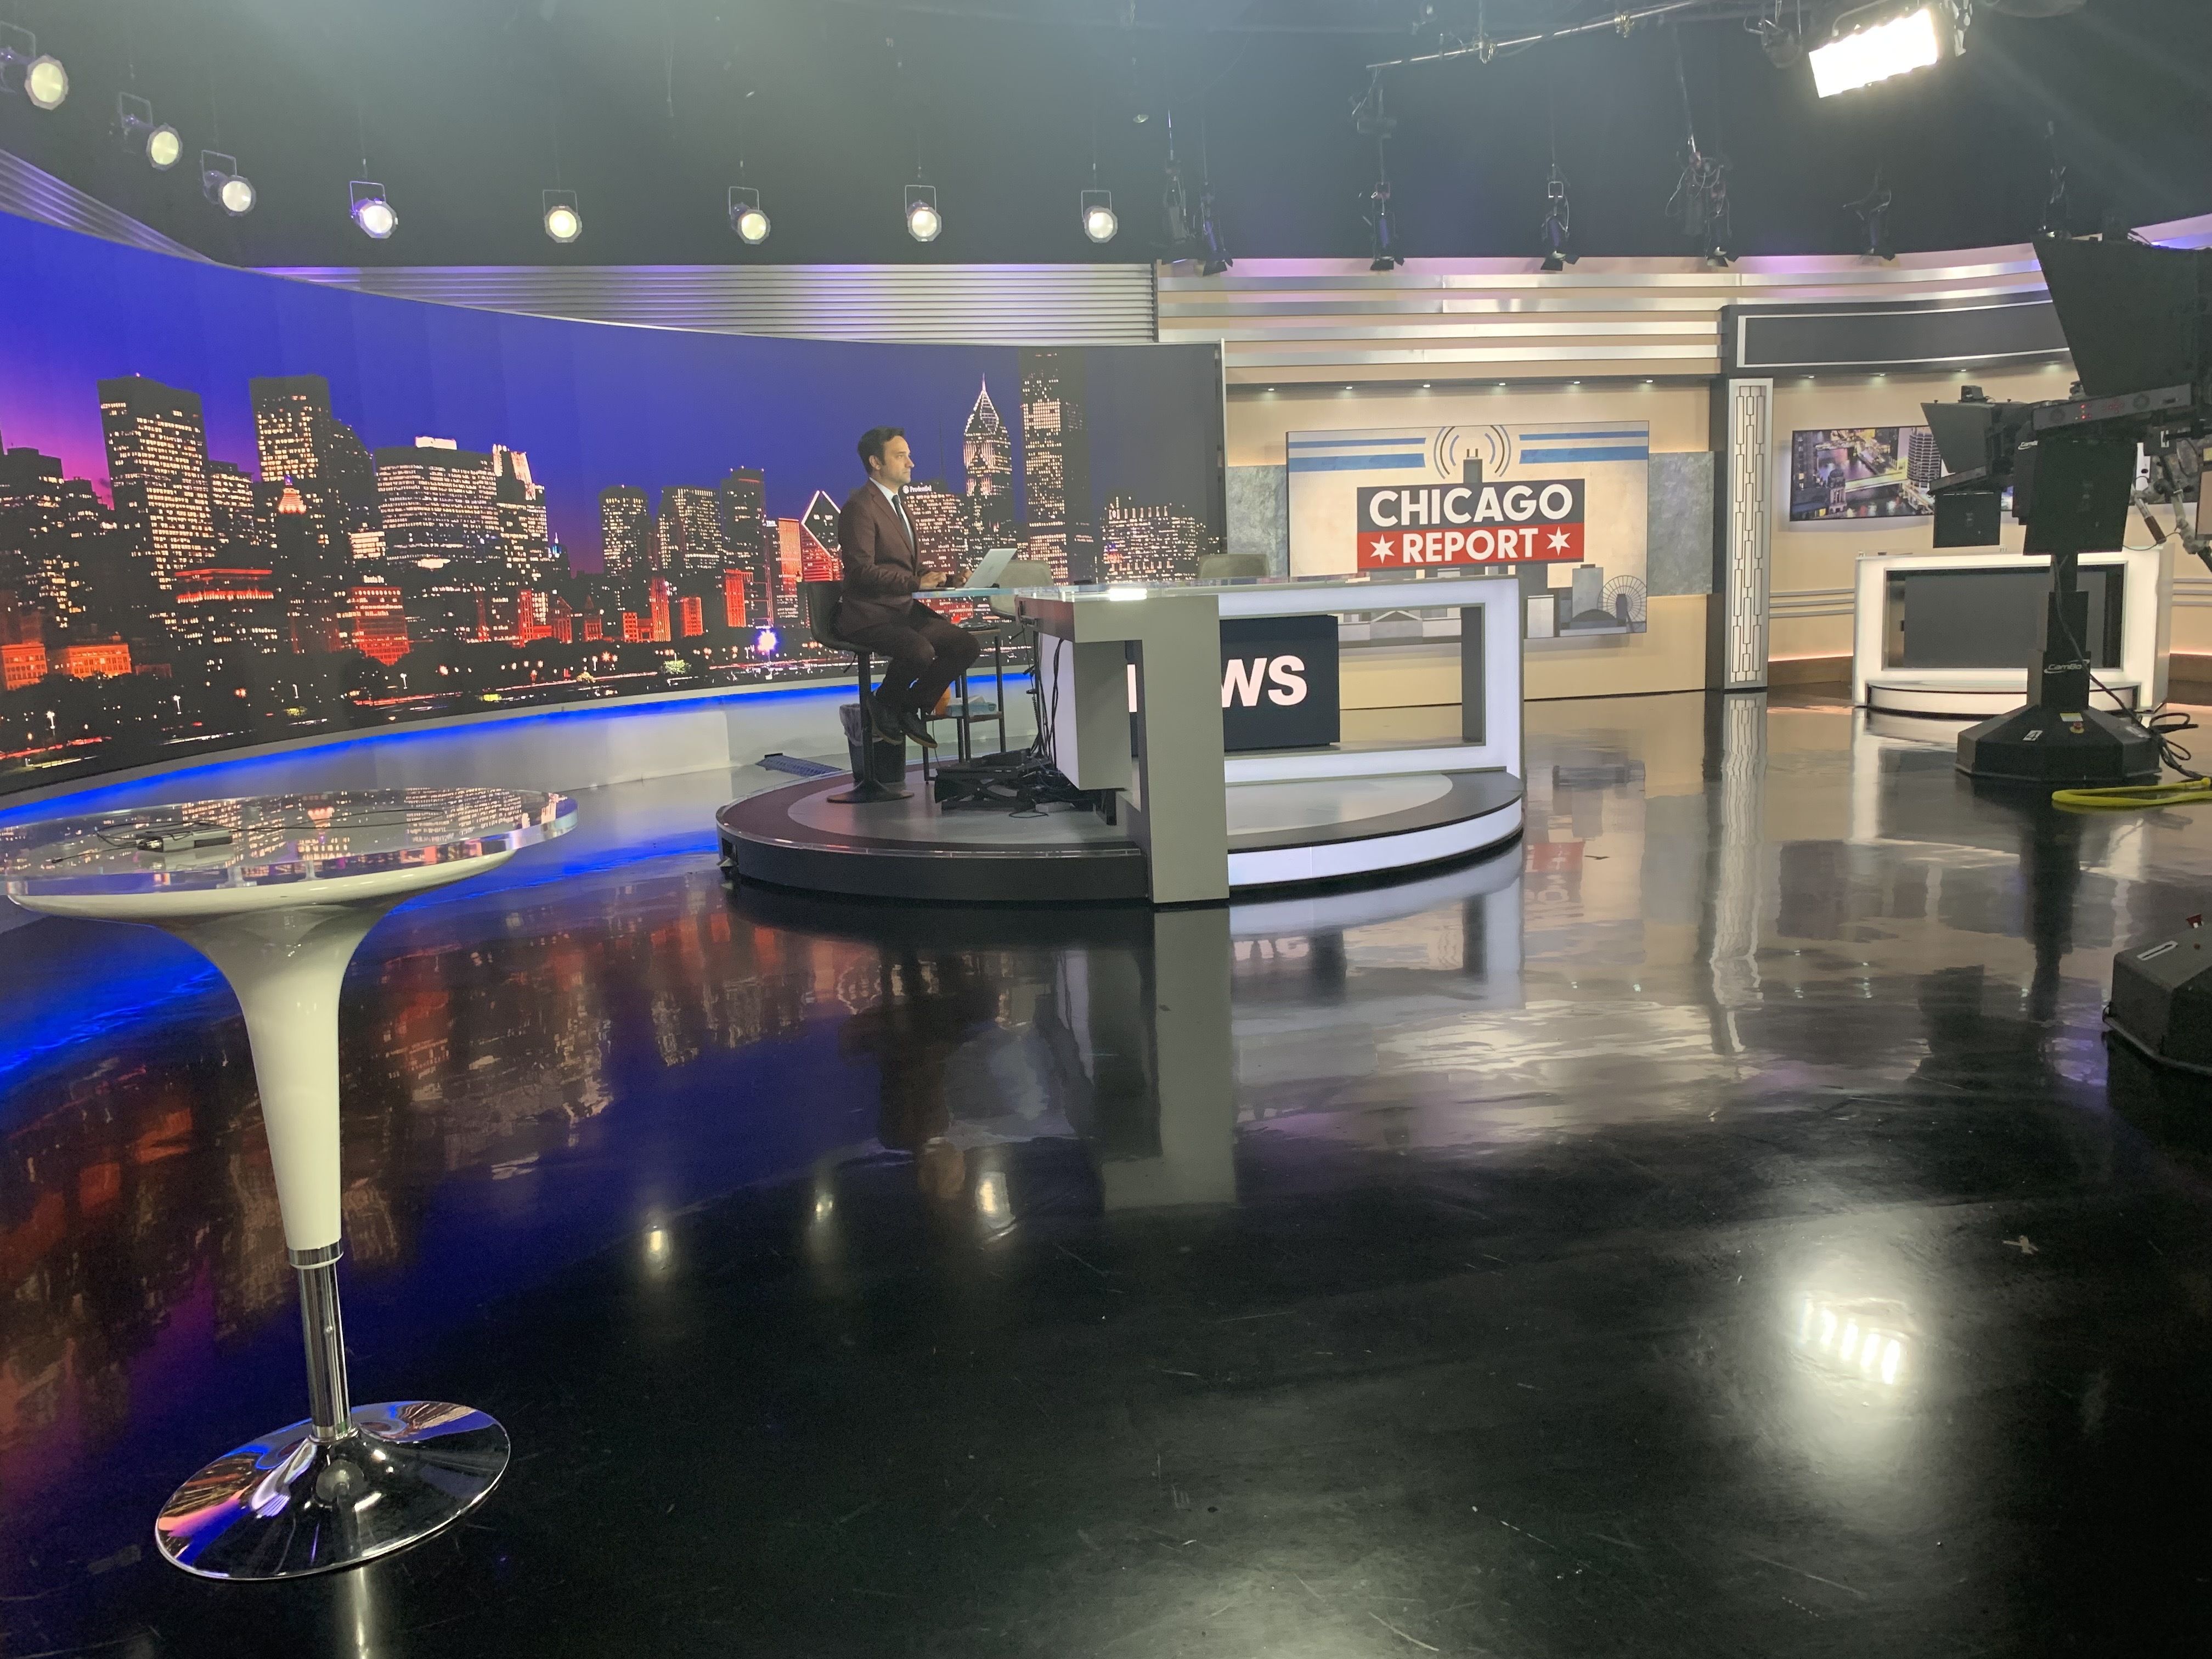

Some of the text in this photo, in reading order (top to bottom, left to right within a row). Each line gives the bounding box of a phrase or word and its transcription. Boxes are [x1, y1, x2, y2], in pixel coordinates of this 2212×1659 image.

[1369, 484, 1573, 527] CHICAGO
[1403, 528, 1539, 563] REPORT
[1221, 655, 1307, 707] WS
